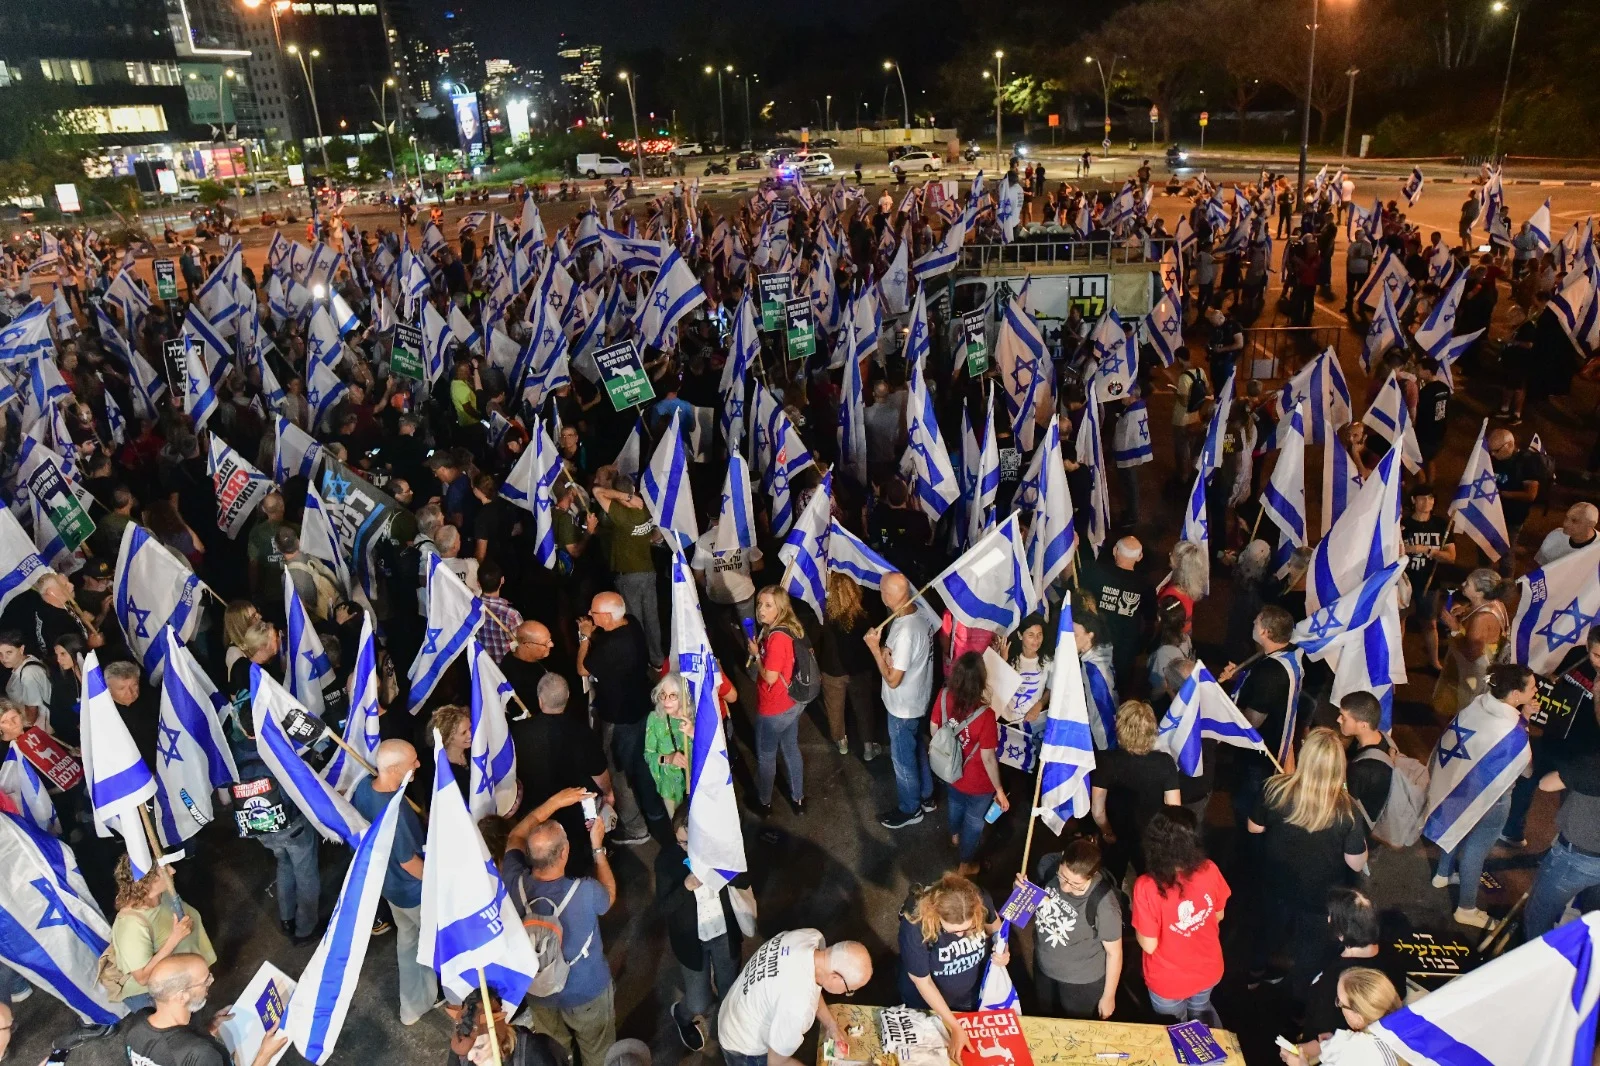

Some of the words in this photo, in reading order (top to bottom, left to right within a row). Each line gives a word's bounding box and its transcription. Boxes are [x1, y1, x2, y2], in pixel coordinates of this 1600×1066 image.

[25, 733, 41, 749] לא
[48, 756, 73, 776] החמורים
[55, 762, 80, 786] שלכם!
[1413, 932, 1435, 944] די
[1418, 956, 1460, 970] בנו!
